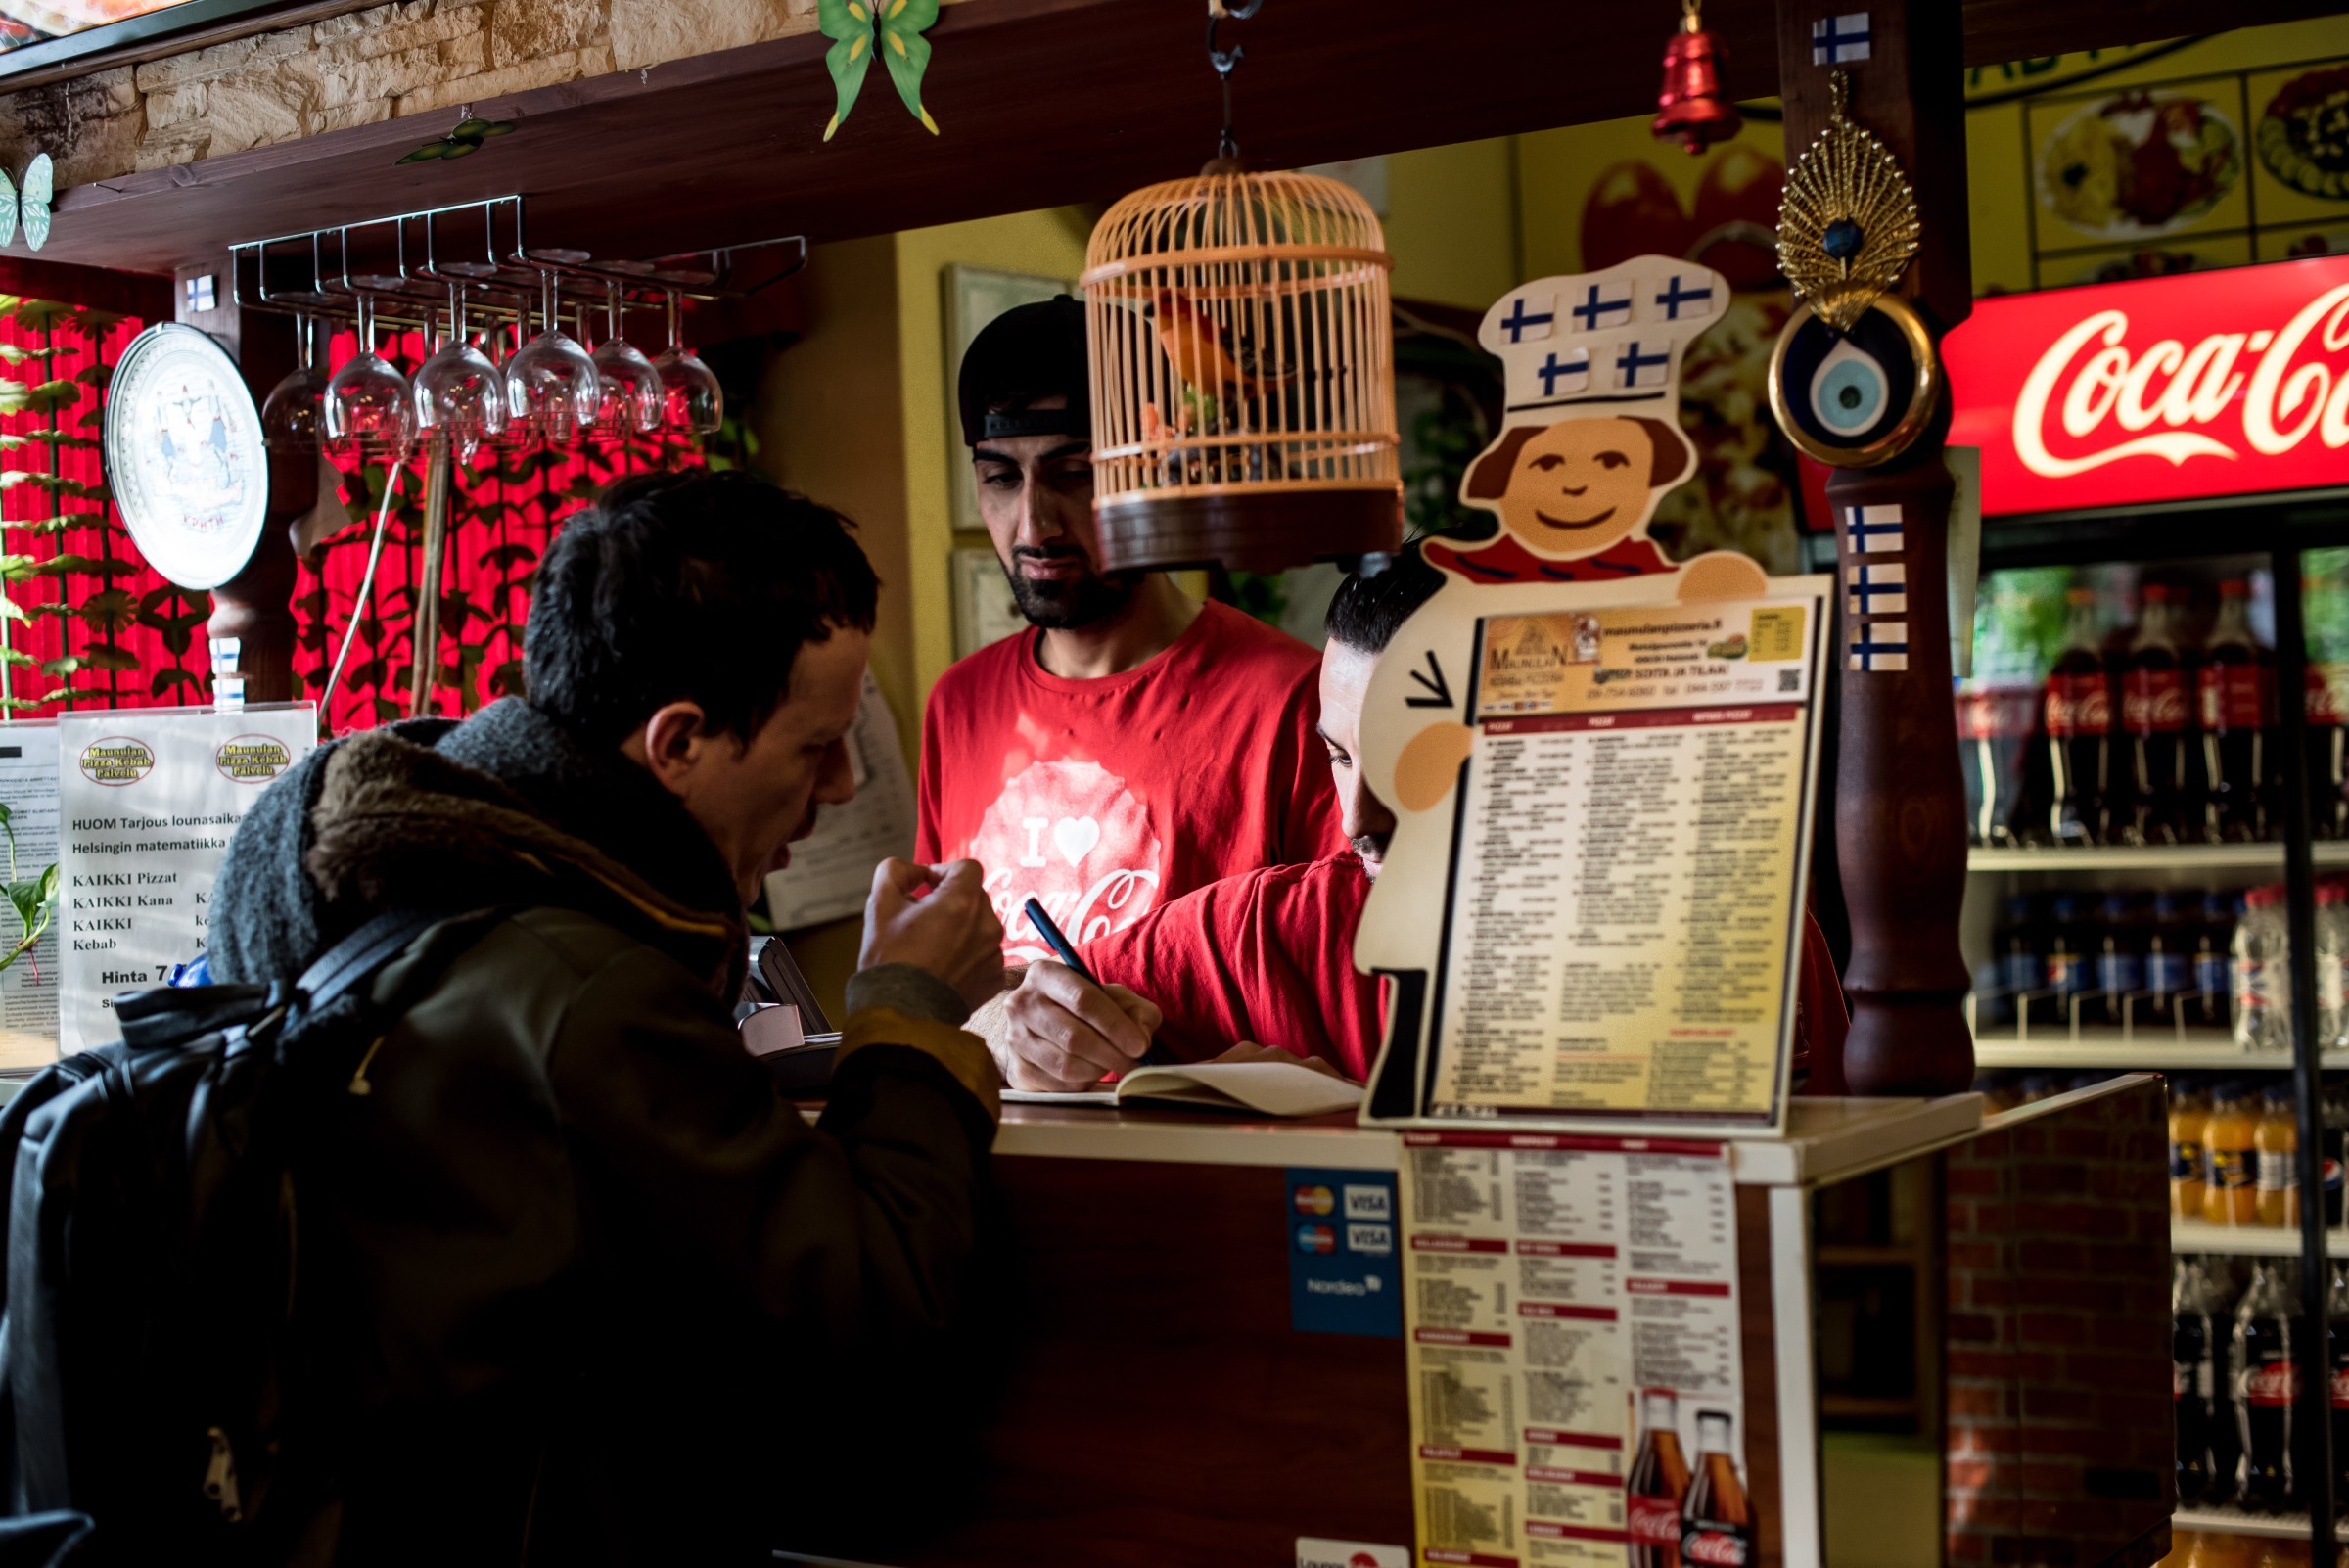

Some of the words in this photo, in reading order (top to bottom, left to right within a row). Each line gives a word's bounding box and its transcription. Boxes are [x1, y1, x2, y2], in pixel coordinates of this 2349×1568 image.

[89, 746, 146, 759] Maunulan
[225, 744, 282, 756] Maunulan
[82, 759, 114, 769] Pizza
[115, 757, 152, 768] Kebab
[219, 757, 249, 767] Pizza
[251, 755, 289, 766] Kebab
[96, 767, 138, 780] Palvelu
[232, 765, 274, 777] Palvelu
[72, 818, 116, 831] HUOM
[120, 816, 168, 831] Tarjous
[72, 842, 132, 855] Helsingin
[136, 838, 226, 853] matematiikka
[1019, 817, 1049, 868] I
[73, 873, 132, 887] KAIKKI
[137, 872, 178, 885] Pizzat
[73, 896, 132, 909] KAIKKI
[137, 895, 173, 906] Kana
[73, 918, 132, 932] KAIKKI
[73, 938, 117, 951] Kebab
[102, 971, 148, 984] Hinta
[1307, 1278, 1366, 1296] Nordea
